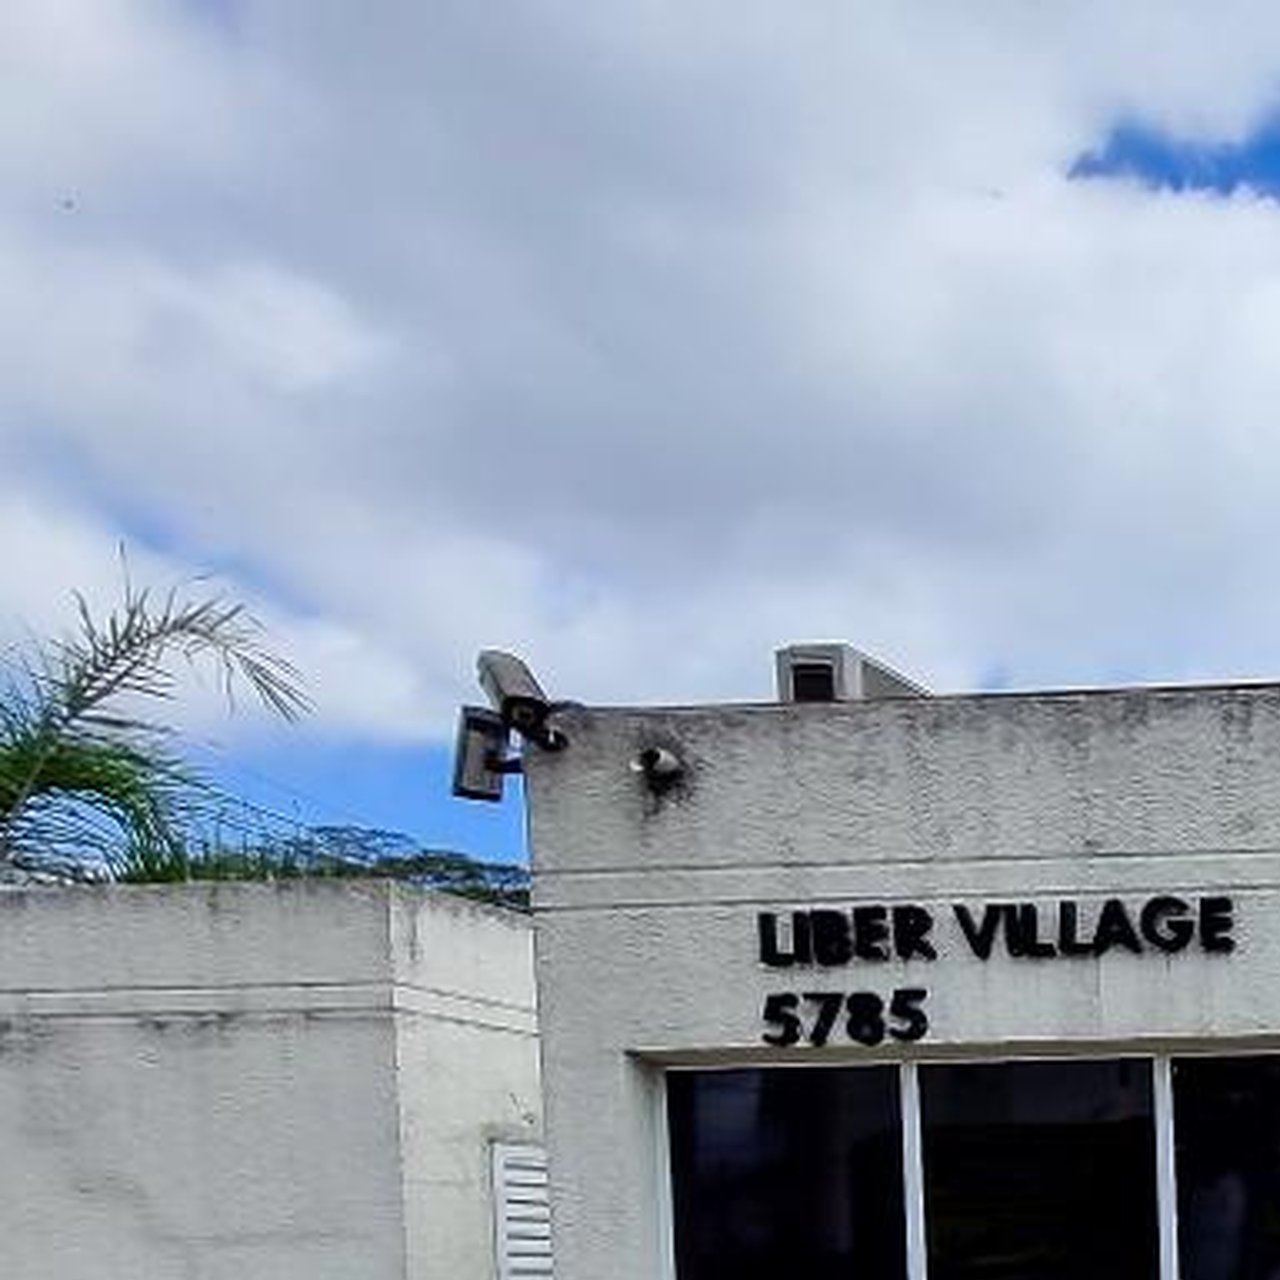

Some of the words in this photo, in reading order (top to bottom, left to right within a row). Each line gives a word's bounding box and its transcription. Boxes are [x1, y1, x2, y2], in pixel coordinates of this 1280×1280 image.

[758, 906, 936, 966] LIBER
[952, 897, 1236, 960] VILLAGE
[762, 989, 928, 1047] 5785
